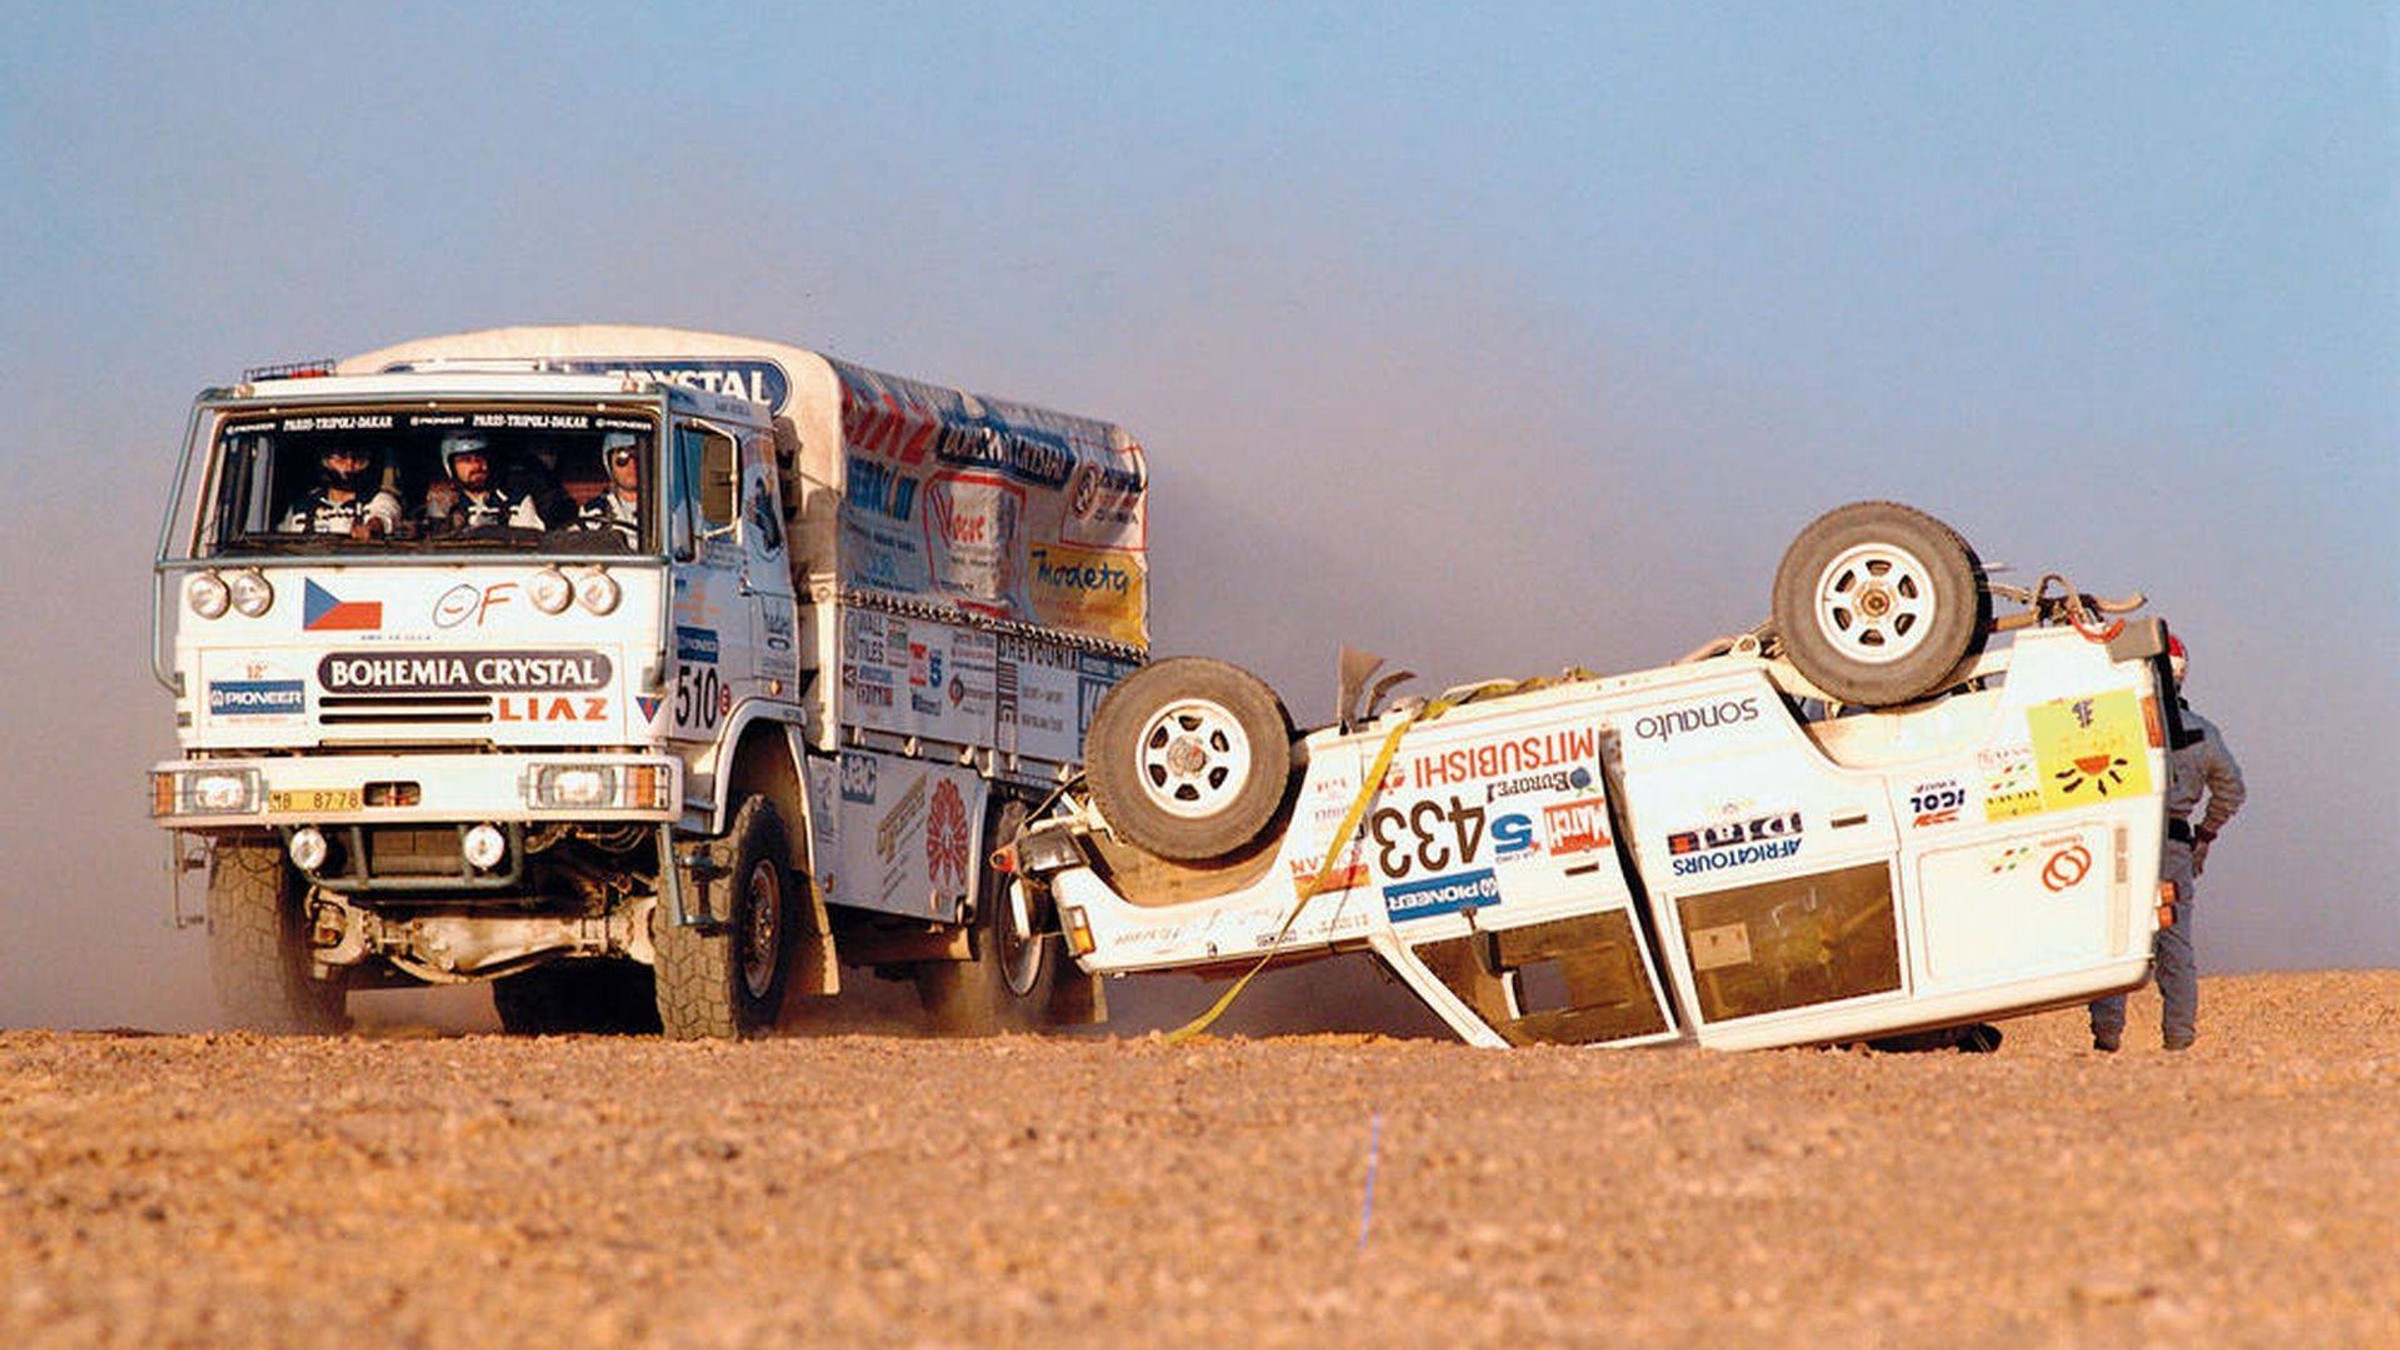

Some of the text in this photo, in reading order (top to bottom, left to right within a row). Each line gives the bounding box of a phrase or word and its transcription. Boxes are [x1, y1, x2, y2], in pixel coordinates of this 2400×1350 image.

[606, 370, 772, 407] RYSTAL
[331, 658, 599, 687] BOHEMIA CRYSTAL
[225, 690, 303, 705] PIONEER
[499, 697, 609, 721] LIAZ
[676, 666, 719, 729] 510
[1634, 698, 1759, 743] sonauto
[1414, 727, 1594, 789] MITSUBISHI
[1371, 795, 1487, 879] 433
[1490, 813, 1533, 854] 5
[1547, 803, 1608, 847] MATCH
[1672, 838, 1802, 877] AFRICATOURS
[1388, 885, 1479, 911] PIONEER
